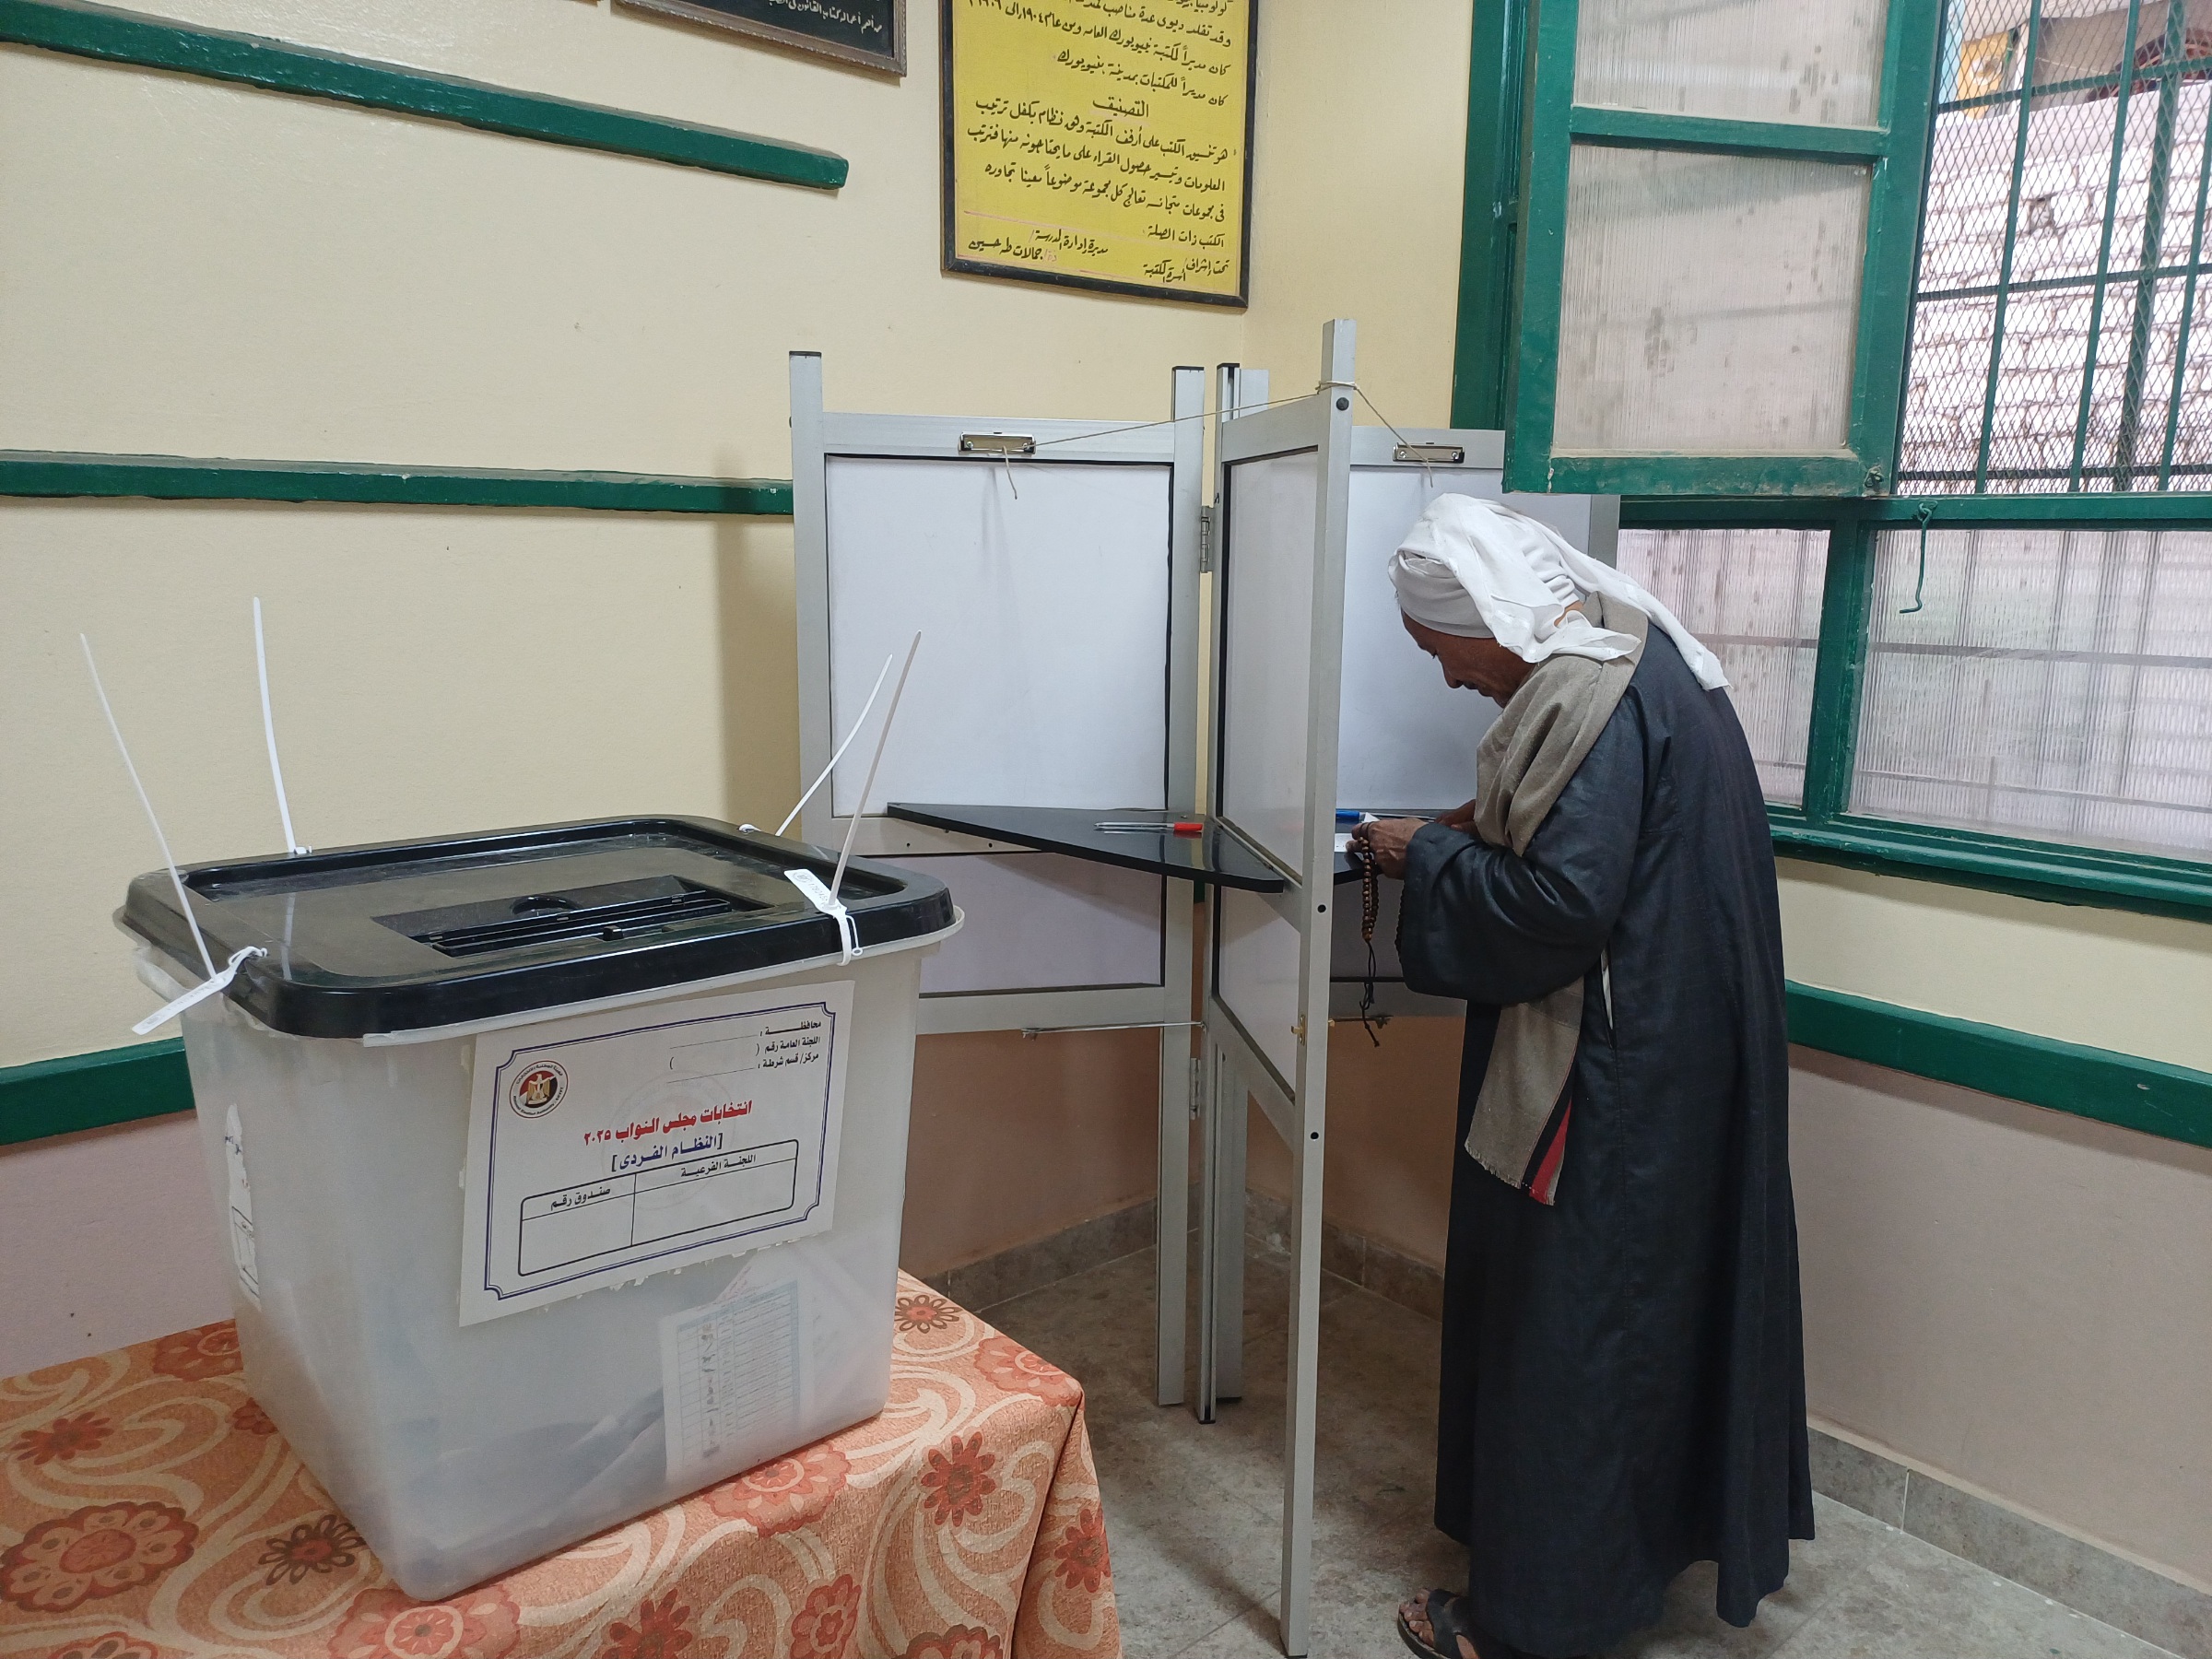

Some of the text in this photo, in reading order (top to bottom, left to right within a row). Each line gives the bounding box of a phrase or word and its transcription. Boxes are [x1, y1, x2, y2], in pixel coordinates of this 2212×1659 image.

[1102, 3, 1135, 18] مناصب
[1139, 6, 1155, 23] عدة
[1208, 31, 1231, 47] وقد
[1108, 64, 1138, 85] بمدينة
[1208, 64, 1231, 76] كان
[1139, 72, 1178, 92] للمكتبات
[975, 98, 1009, 115] ترتيب
[1207, 95, 1229, 107] كان
[1009, 100, 1040, 124] يكفل
[1039, 107, 1064, 125] نظام
[1001, 128, 1019, 148] منها
[1086, 120, 1113, 138] المكتبة
[1142, 135, 1159, 148] على
[1160, 139, 1186, 157] الكتب
[1073, 145, 1091, 160] على
[1213, 148, 1228, 164] هو
[1120, 158, 1151, 176] حصول
[1111, 183, 1128, 202] كل
[1184, 177, 1225, 193] المعلومات
[1123, 187, 1147, 207] تعالج
[1182, 204, 1214, 220] مجموعات
[968, 238, 1002, 252] حسين
[999, 237, 1013, 255] طه
[1088, 239, 1109, 257] مديرة
[1199, 233, 1226, 250] الكتب
[1213, 259, 1230, 275] تحت
[764, 1036, 820, 1054] اللجنة العامة رقم
[784, 1053, 799, 1066] قسم
[583, 1100, 753, 1147] انتخابات مجلس النواب ٢٠٢٥
[680, 1154, 757, 1177] اللجنة الفرعية
[550, 1186, 611, 1211] صندوق رقم
